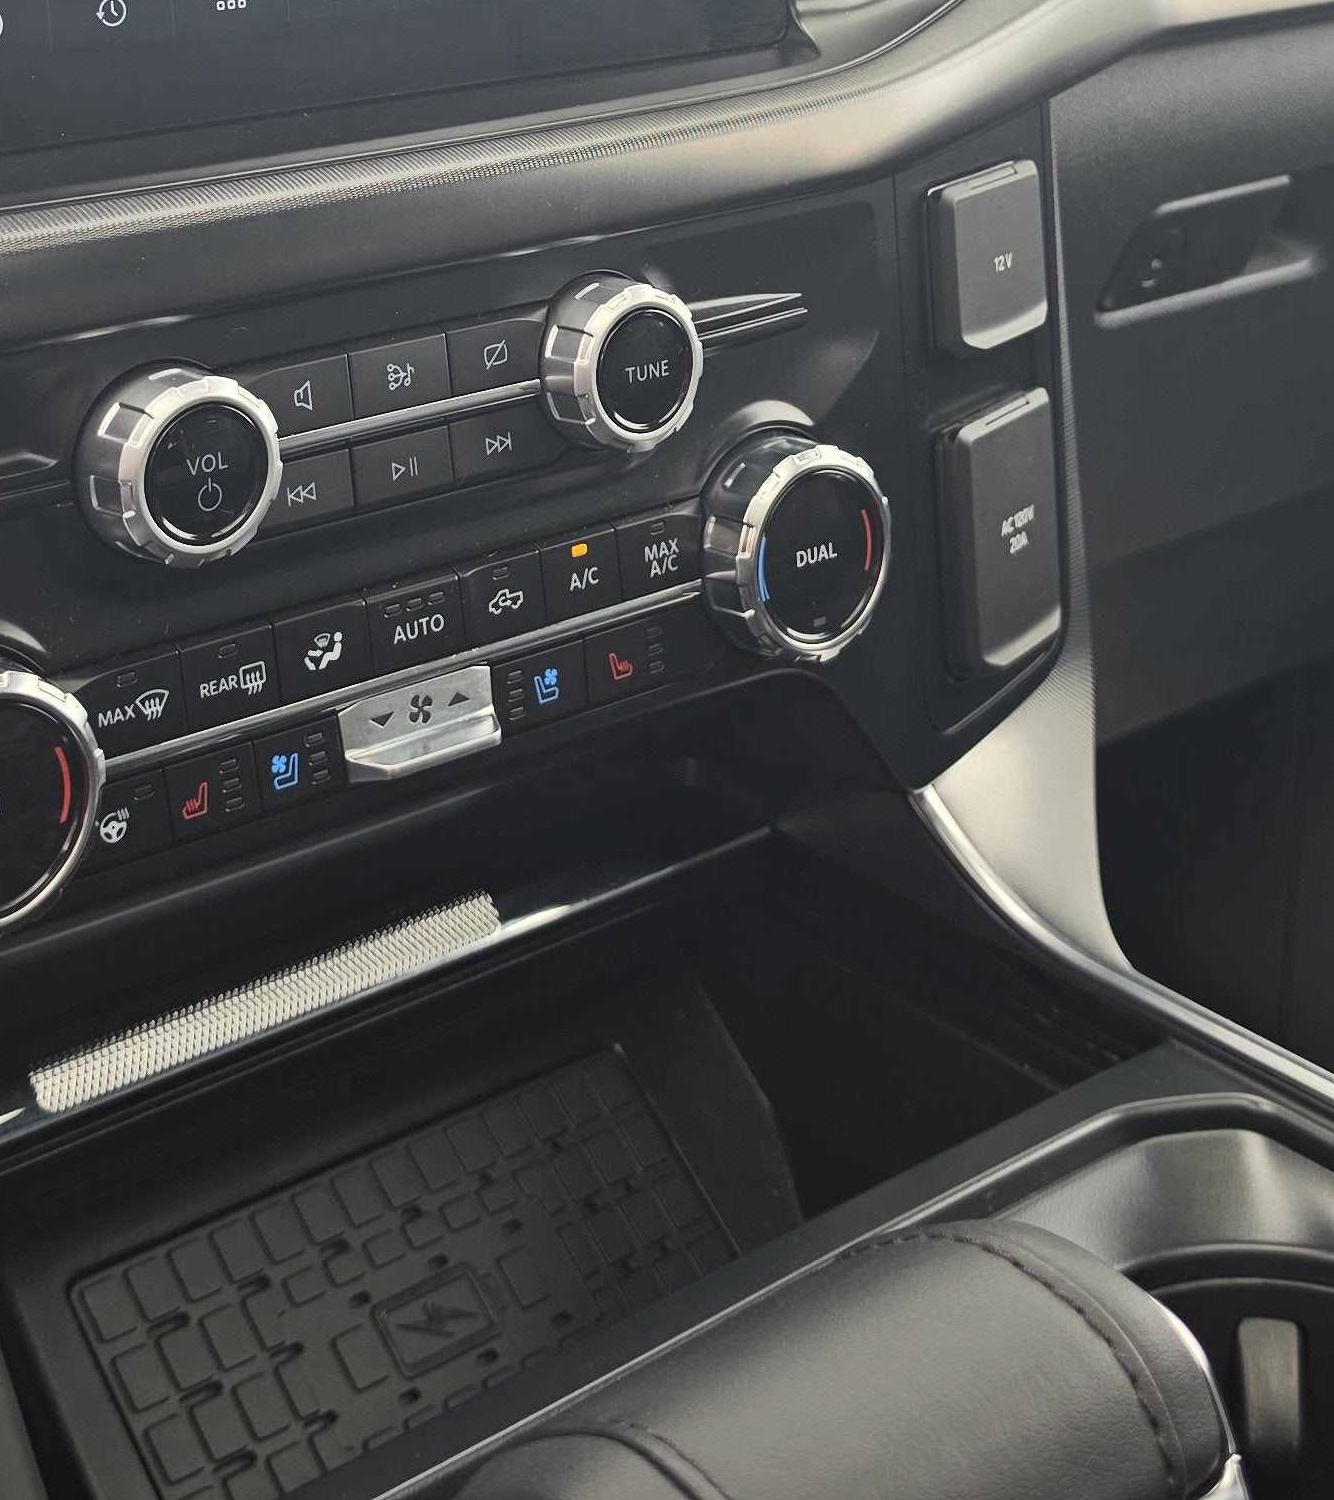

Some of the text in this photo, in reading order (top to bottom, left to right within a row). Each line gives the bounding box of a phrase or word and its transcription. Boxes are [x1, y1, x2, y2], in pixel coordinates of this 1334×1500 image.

[993, 252, 1013, 273] 12V
[624, 359, 670, 383] TUNE
[186, 453, 229, 475] VOL
[643, 537, 680, 562] MAX
[796, 541, 838, 568] DUAL
[649, 553, 679, 578] A/C
[569, 566, 600, 591] A/C
[393, 613, 445, 645] AUTO
[199, 675, 238, 699] REAR
[98, 703, 136, 728] MAX
